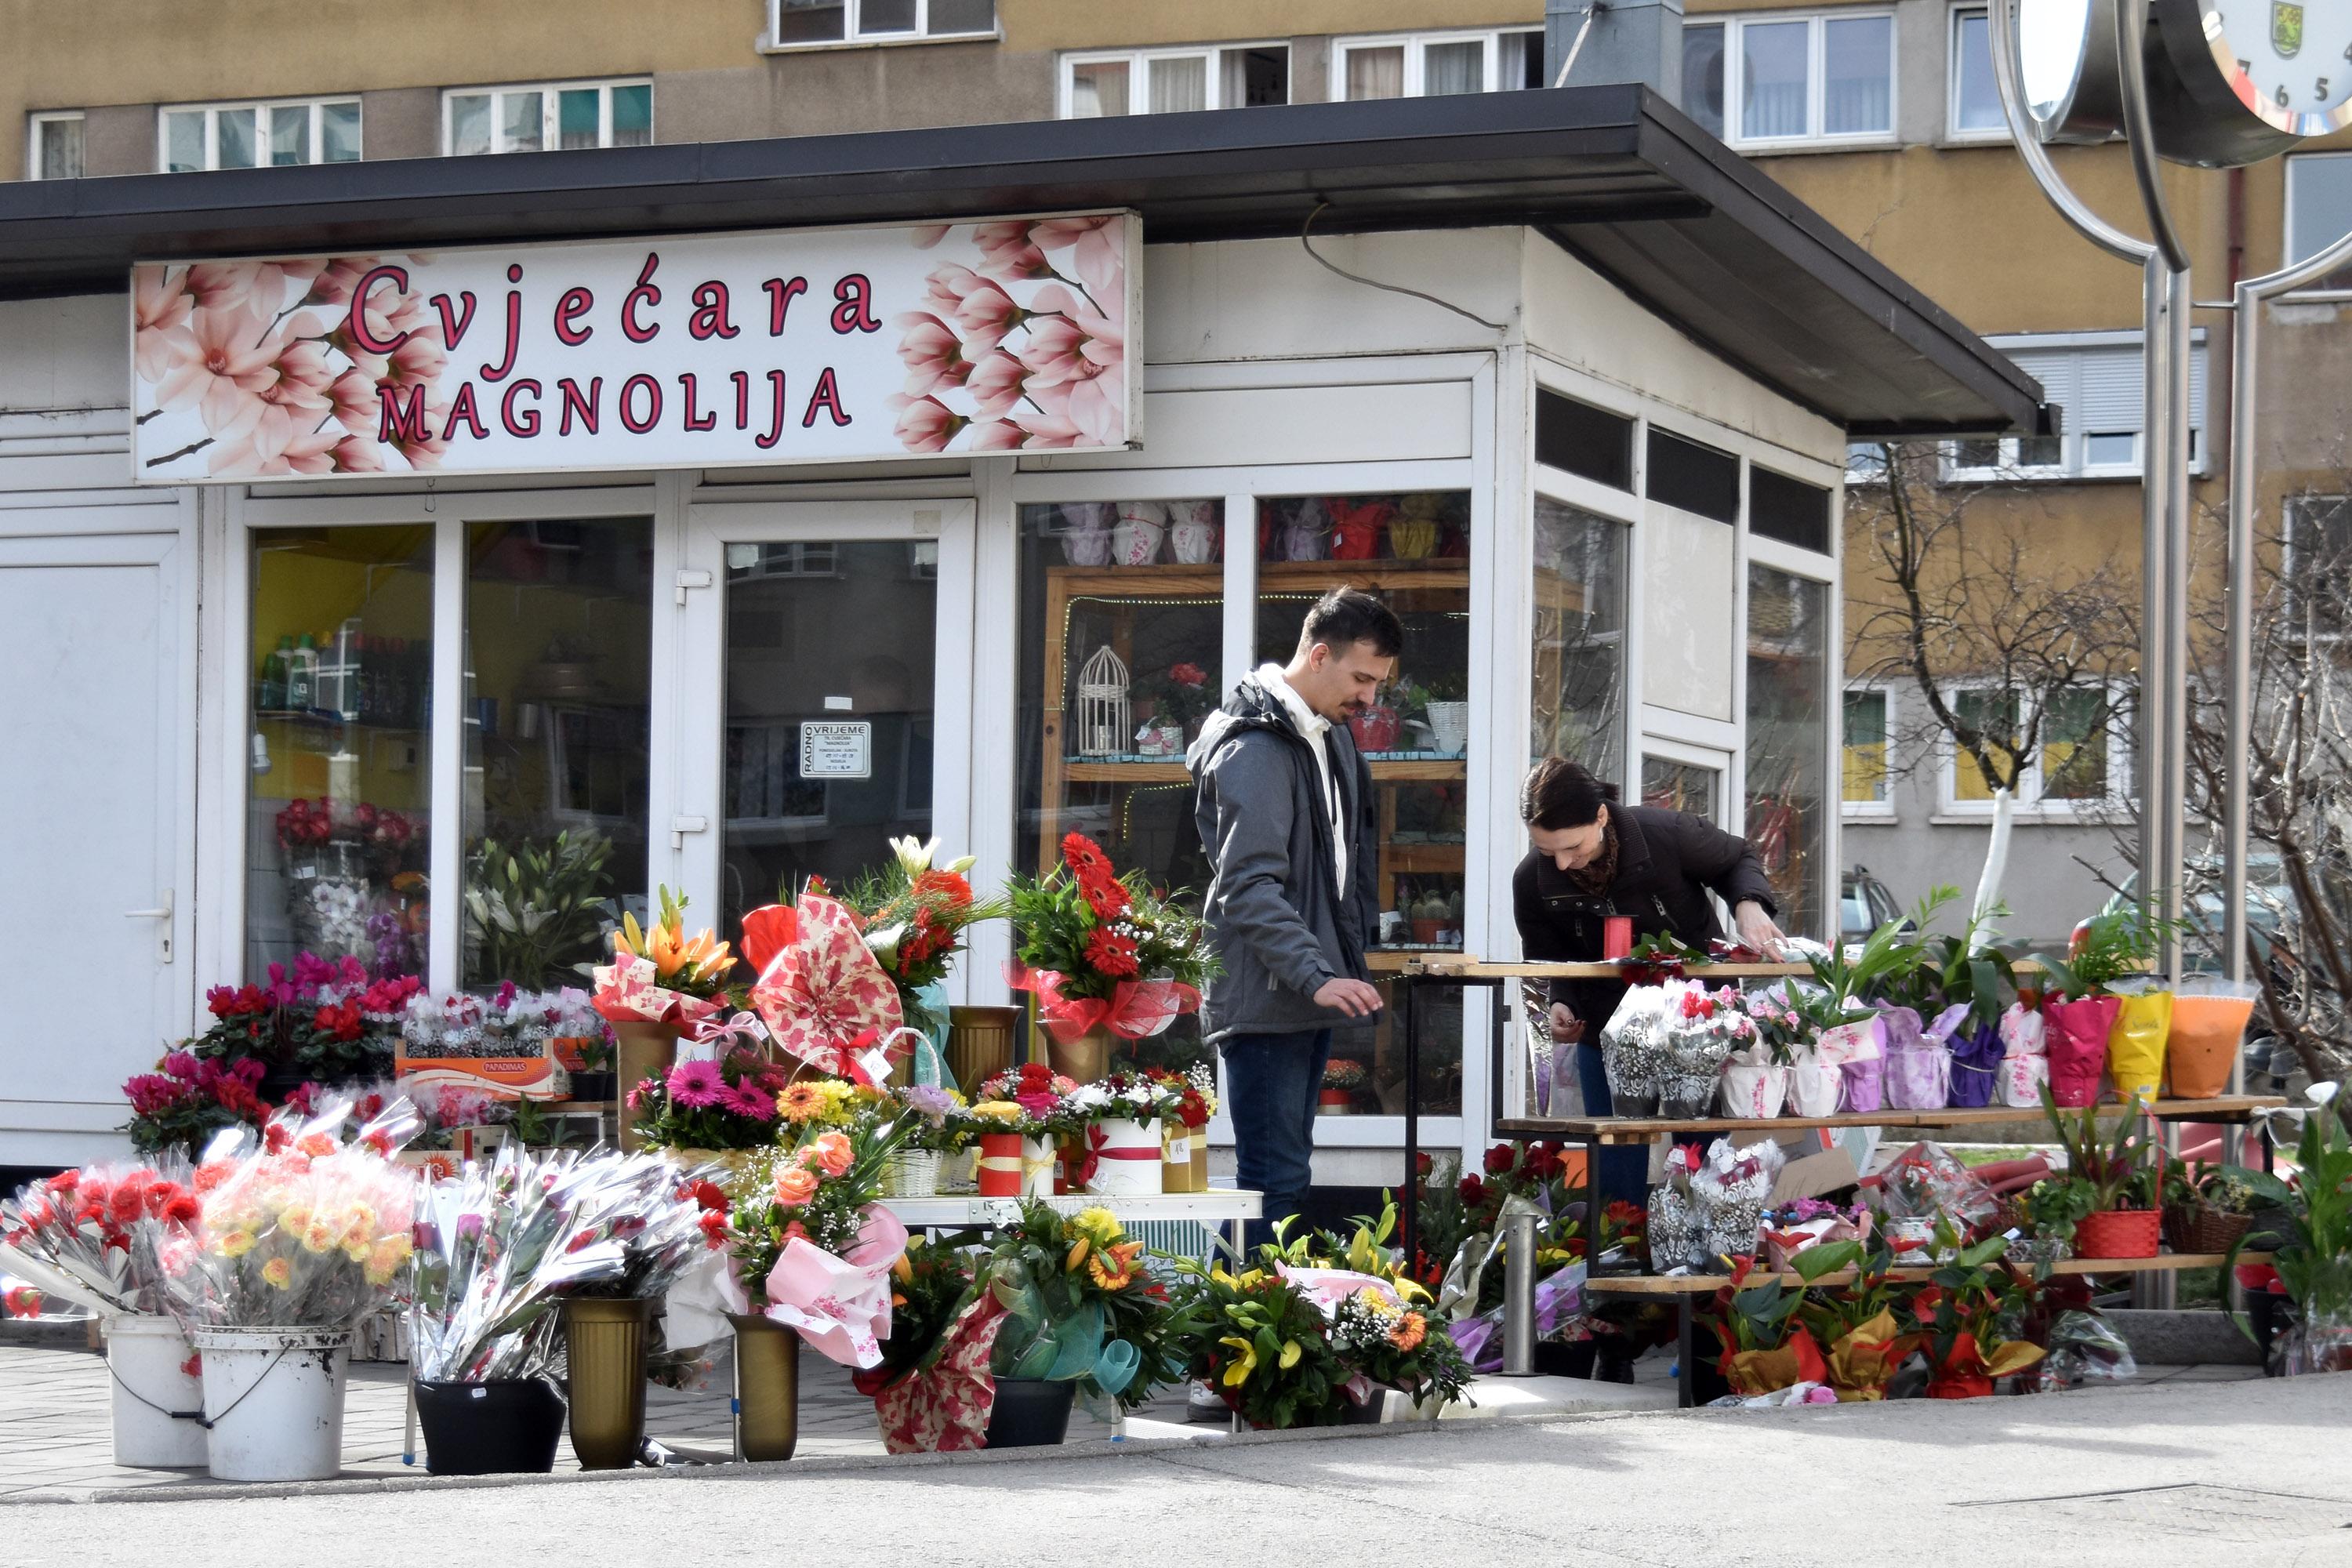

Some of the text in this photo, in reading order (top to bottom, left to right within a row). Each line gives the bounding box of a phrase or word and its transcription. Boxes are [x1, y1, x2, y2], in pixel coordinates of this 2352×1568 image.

[2275, 84, 2289, 108] 6
[2314, 77, 2328, 102] 5
[349, 252, 883, 383] Cvjećara
[376, 366, 853, 450] MAGNOLIJA
[804, 726, 813, 772] RADNO
[485, 1062, 526, 1072] PAPADIMAS
[1175, 1142, 1184, 1155] 18
